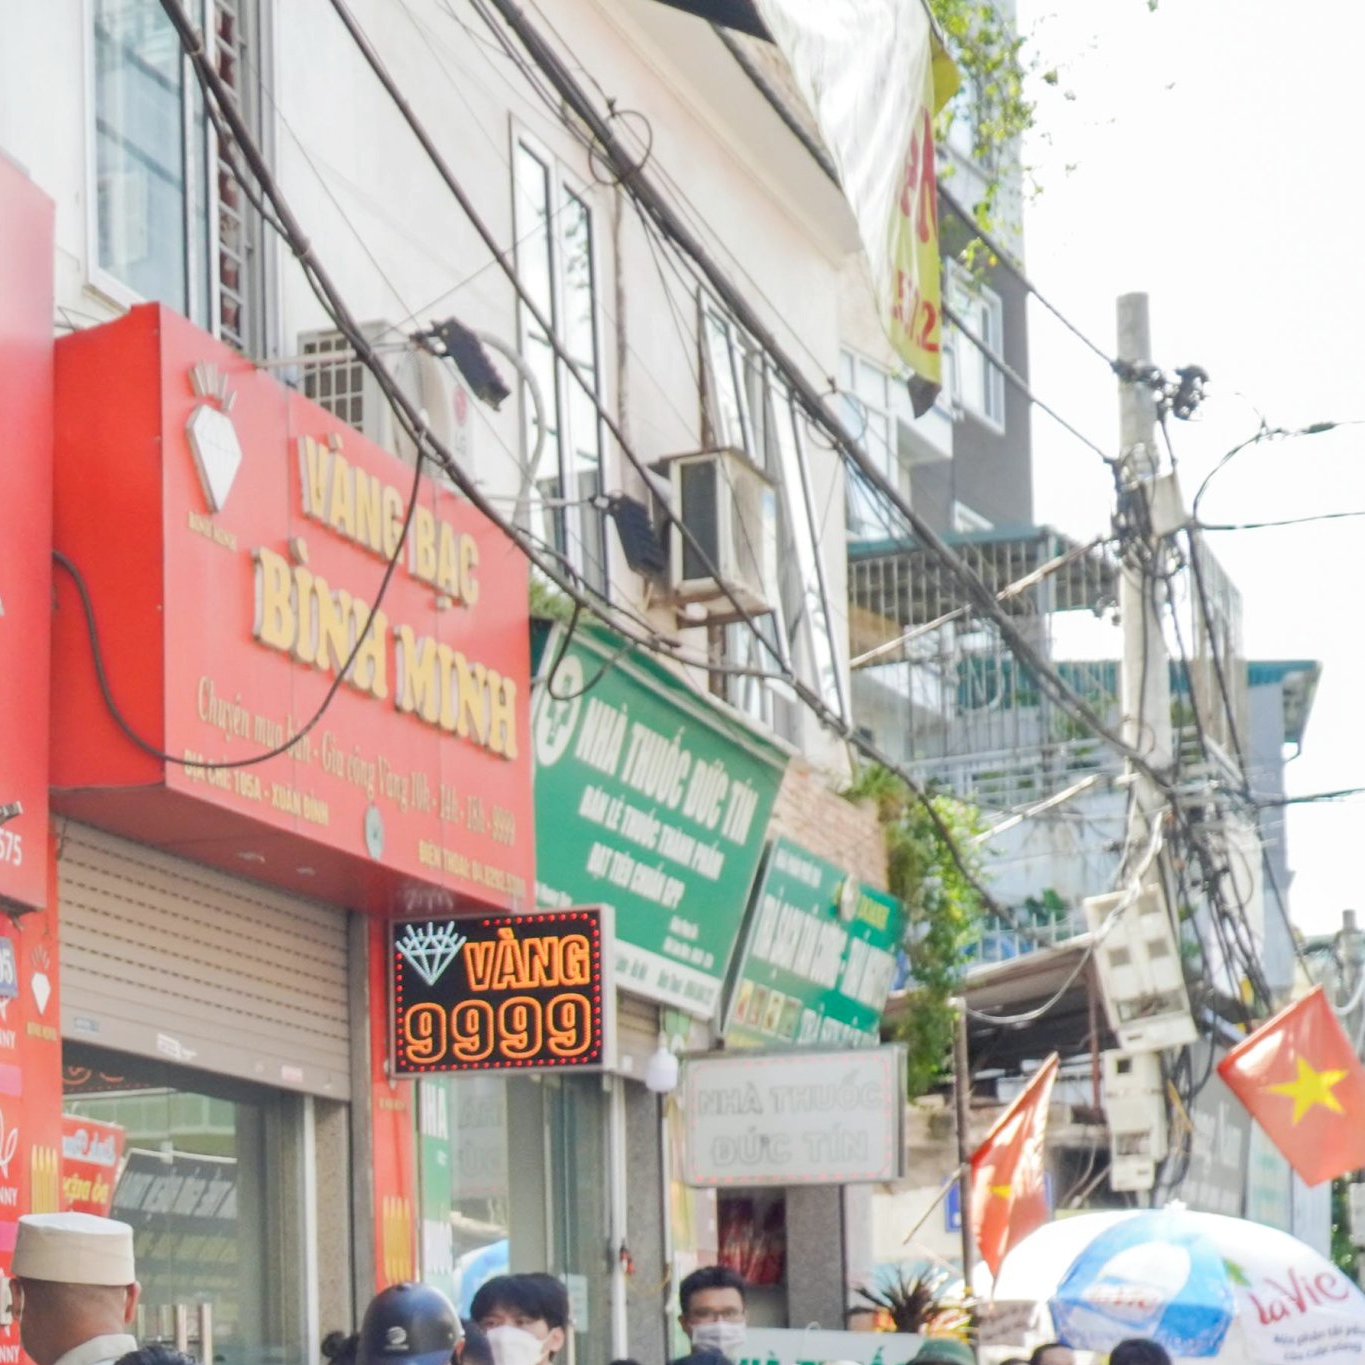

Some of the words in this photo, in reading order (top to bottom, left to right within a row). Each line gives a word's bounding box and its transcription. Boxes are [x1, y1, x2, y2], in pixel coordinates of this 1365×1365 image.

[297, 433, 406, 566] VÀNG
[409, 498, 481, 611] BẠC
[252, 537, 388, 700] BÌNH
[393, 622, 519, 761] MINH
[574, 696, 628, 777] NHÀ
[621, 722, 692, 811] THUỐC
[464, 929, 591, 992] VÀNG
[404, 993, 592, 1065] 9999
[767, 1068, 881, 1114] THUỐC
